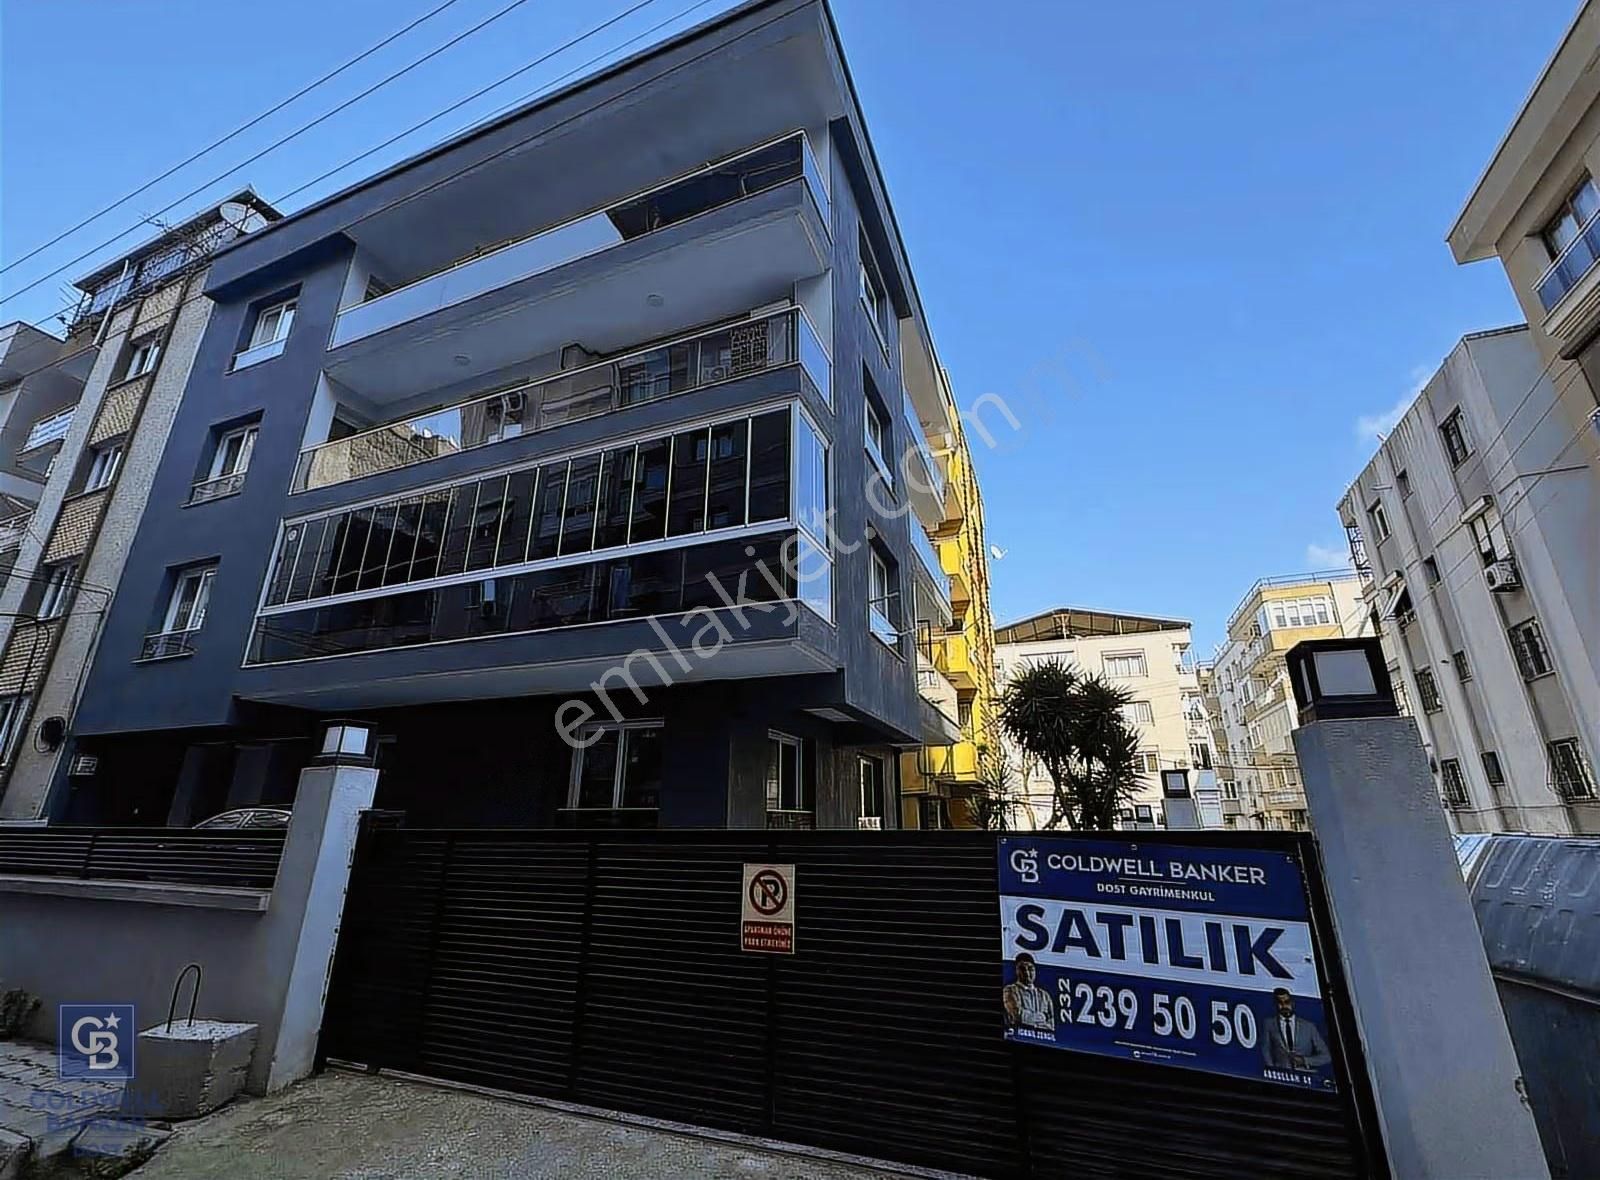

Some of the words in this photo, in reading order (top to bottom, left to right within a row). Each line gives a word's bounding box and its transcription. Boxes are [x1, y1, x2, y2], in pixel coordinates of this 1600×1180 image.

[1047, 853, 1163, 877] COLDWELL
[1170, 862, 1267, 885] BANKER
[1097, 883, 1126, 895] DOST
[1129, 884, 1216, 902] GAYRİMENKUL
[1014, 903, 1296, 980] SATILIK
[1058, 977, 1073, 1024] 232
[1075, 982, 1138, 1030] 239
[1153, 993, 1196, 1040] 50
[1211, 1000, 1257, 1049] 50
